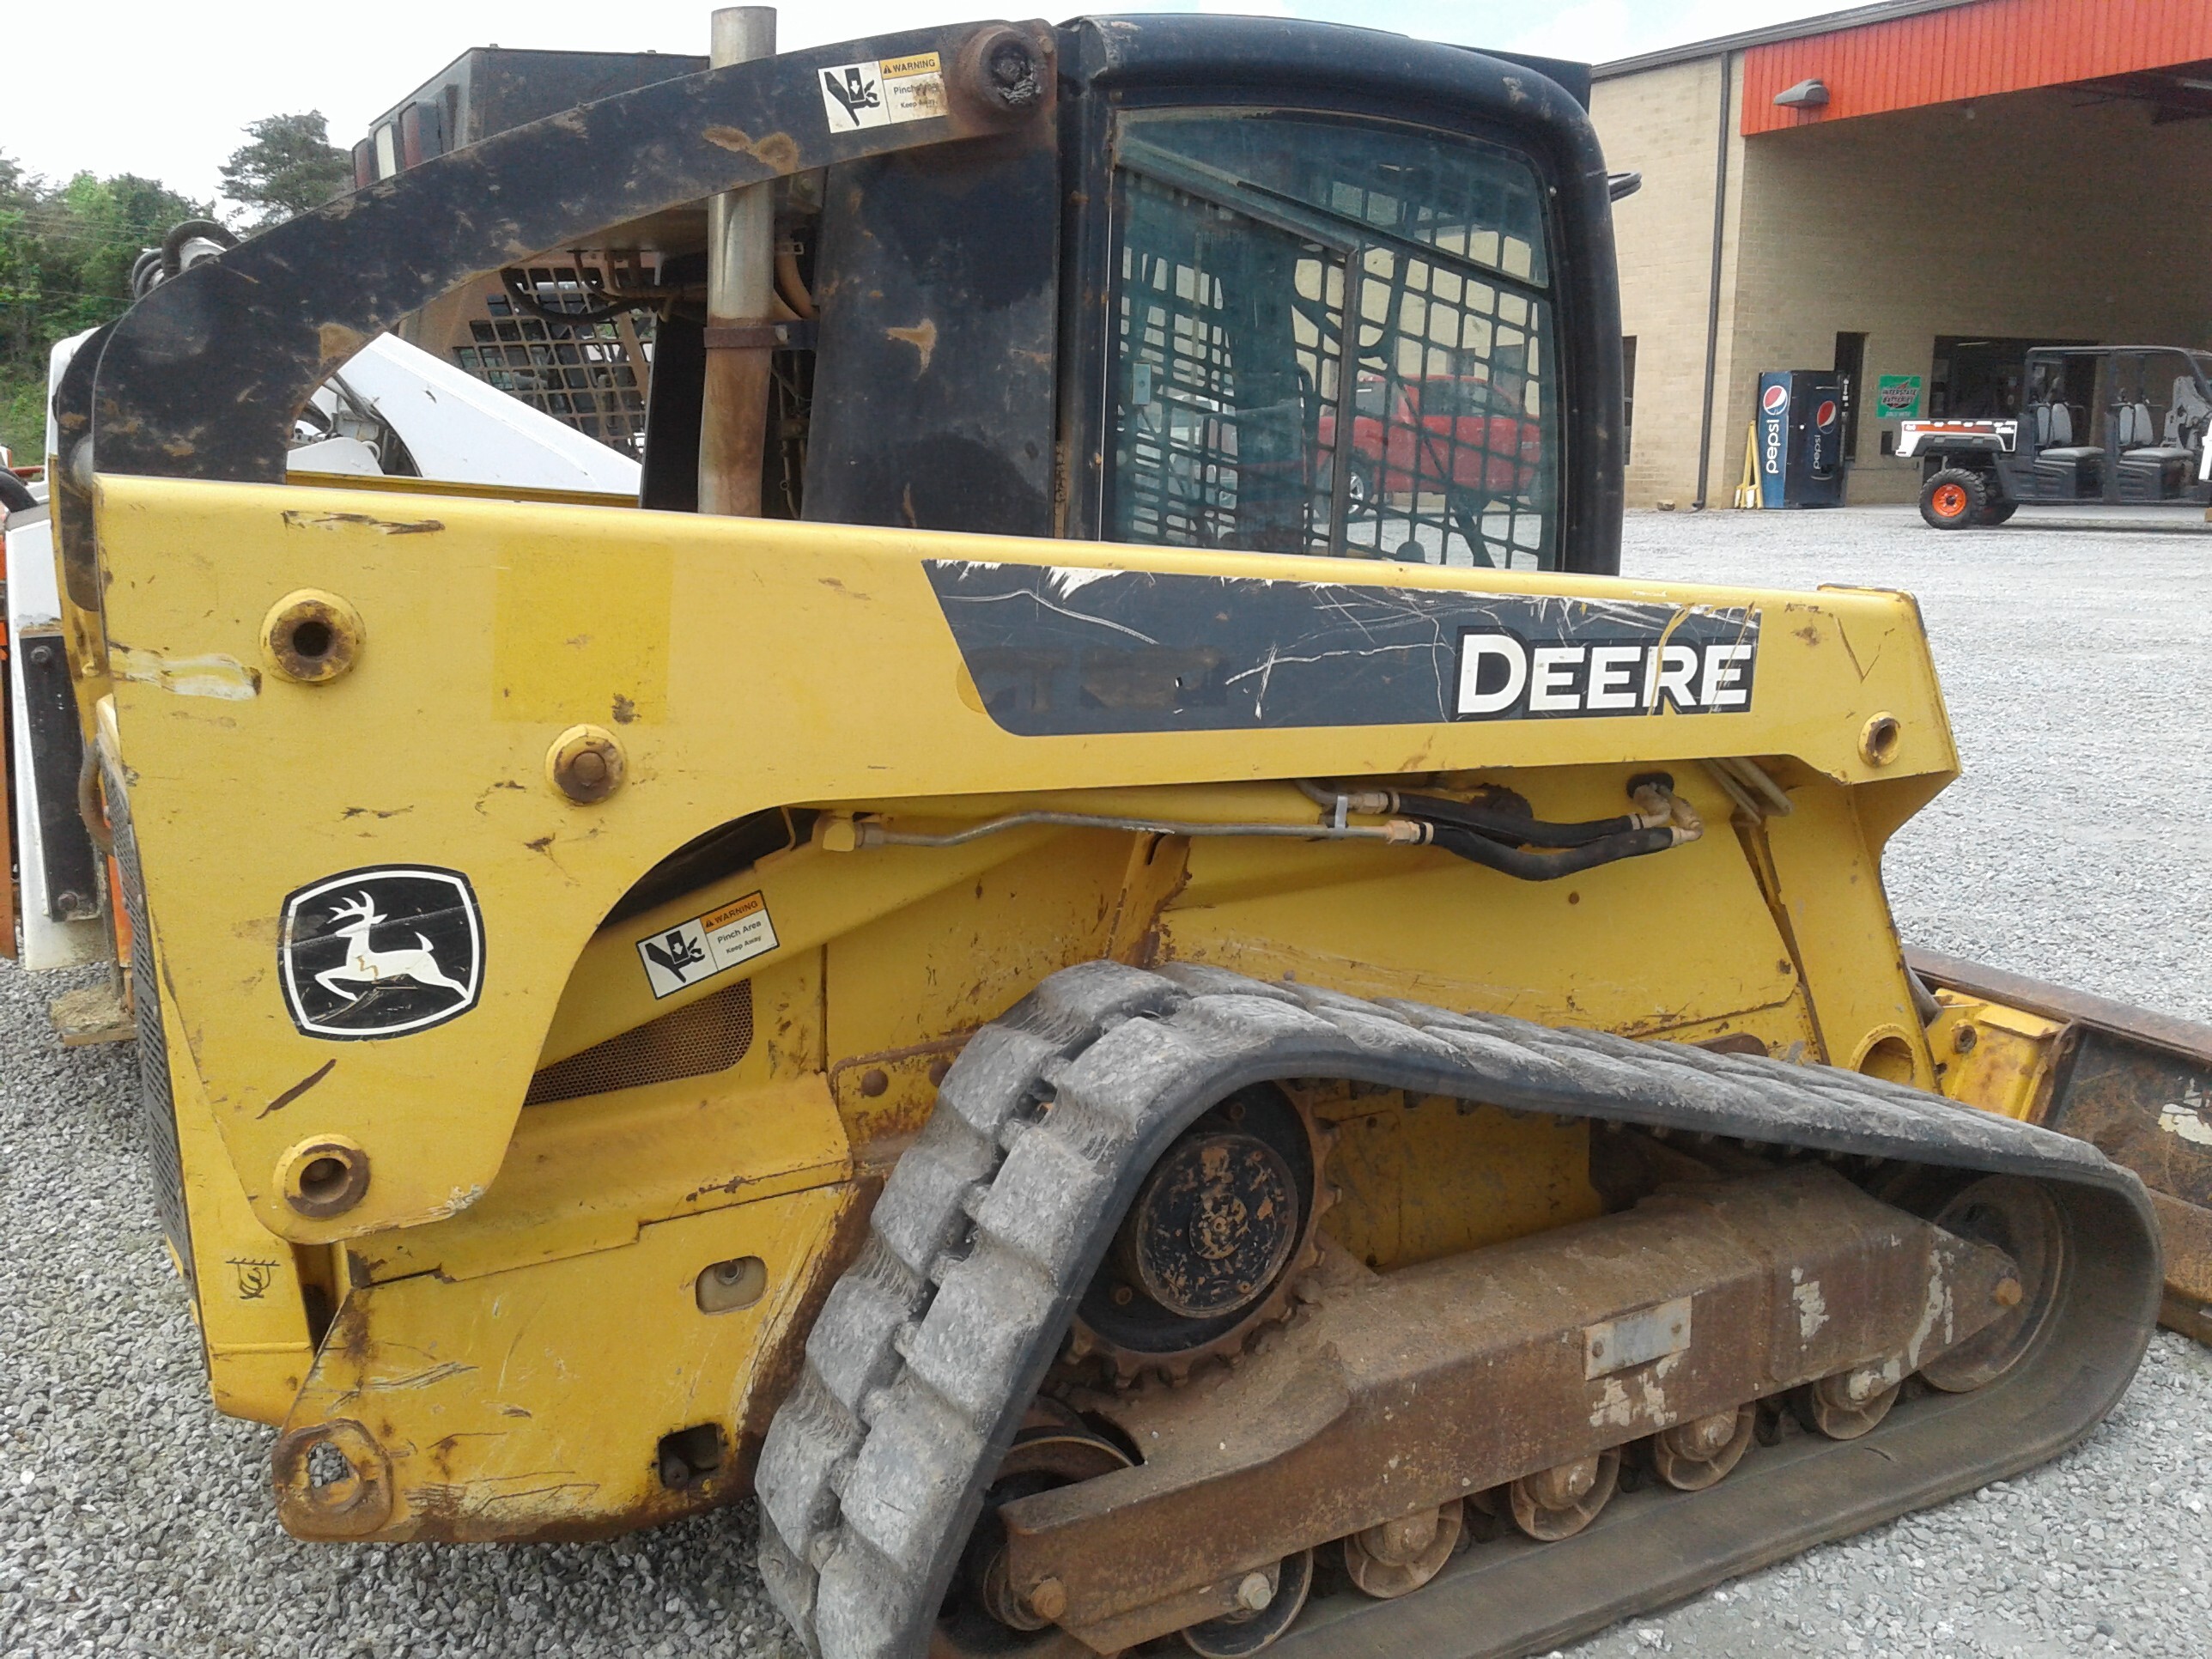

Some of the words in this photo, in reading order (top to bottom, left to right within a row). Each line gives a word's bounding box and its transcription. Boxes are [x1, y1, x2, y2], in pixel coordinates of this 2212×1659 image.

[892, 58, 935, 73] WARNING
[1765, 419, 1781, 474] pepsi
[1813, 434, 1822, 470] pepsi
[1457, 634, 1752, 714] DEERE
[714, 900, 758, 924] WARNING
[717, 929, 741, 944] Pinch
[742, 921, 762, 933] Area
[726, 944, 744, 954] Keep
[744, 936, 762, 946] Away
